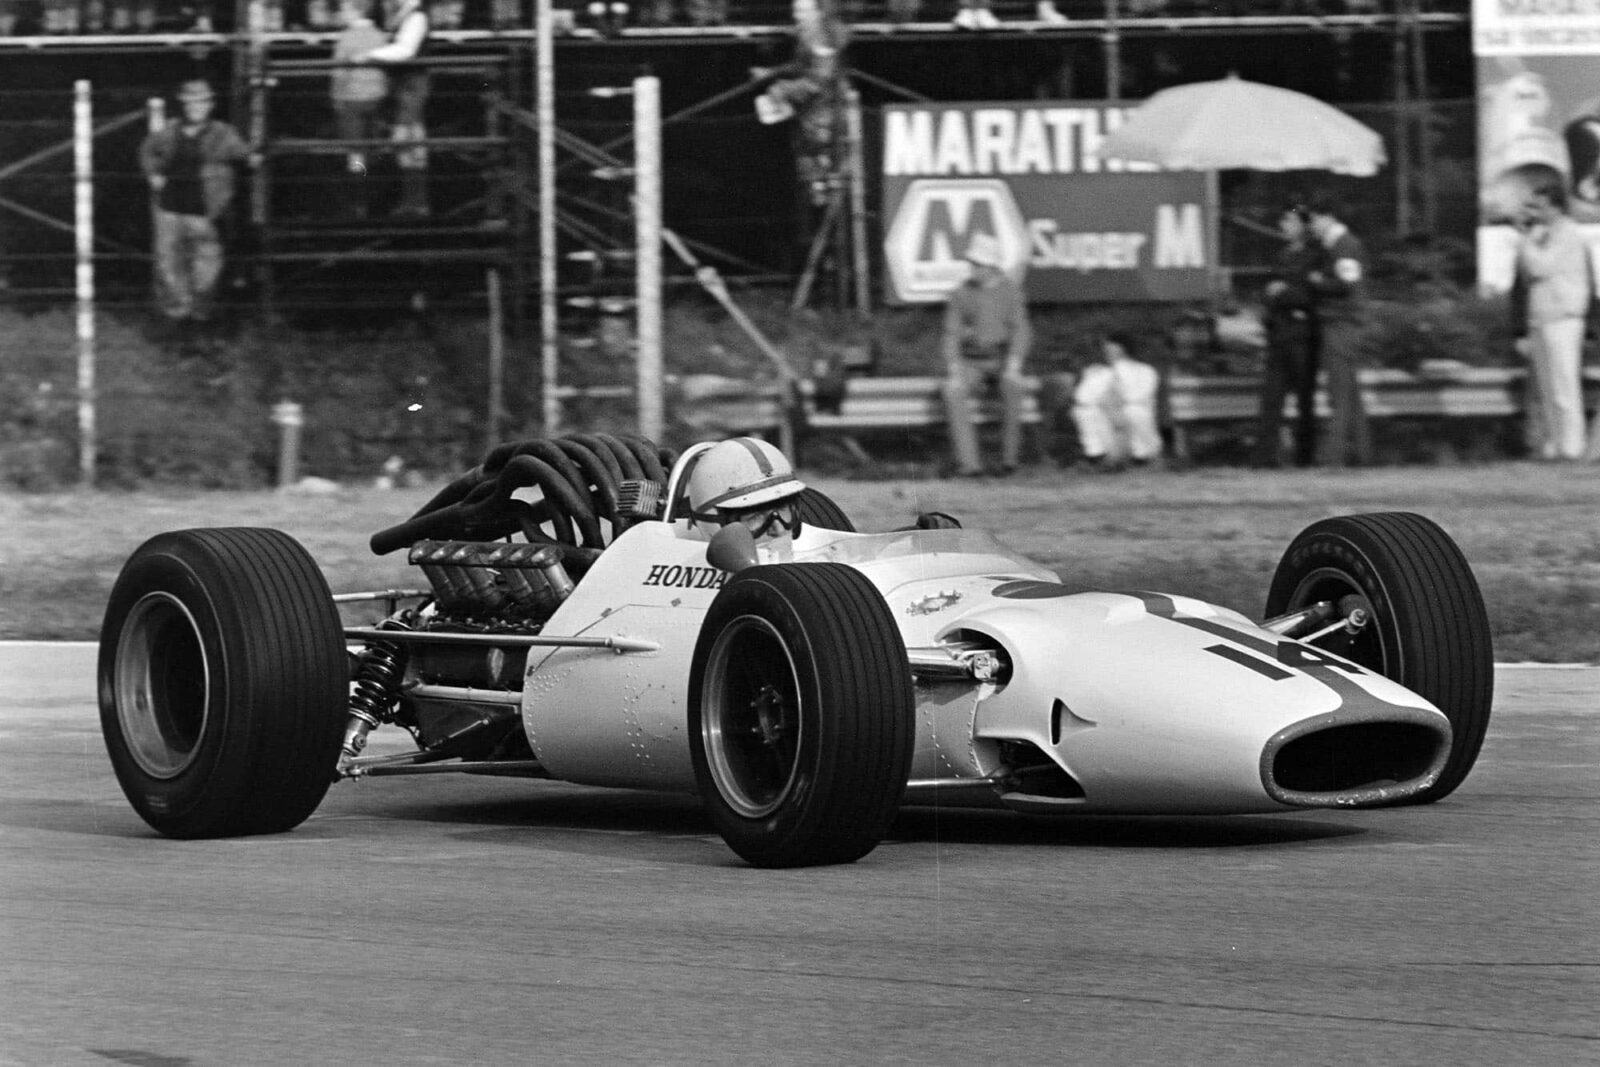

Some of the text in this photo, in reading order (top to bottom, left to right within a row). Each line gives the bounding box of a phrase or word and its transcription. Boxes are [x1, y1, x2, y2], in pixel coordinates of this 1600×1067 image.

[884, 108, 1162, 175] MARATH
[1154, 203, 1204, 269] M
[642, 564, 731, 590] HONDA
